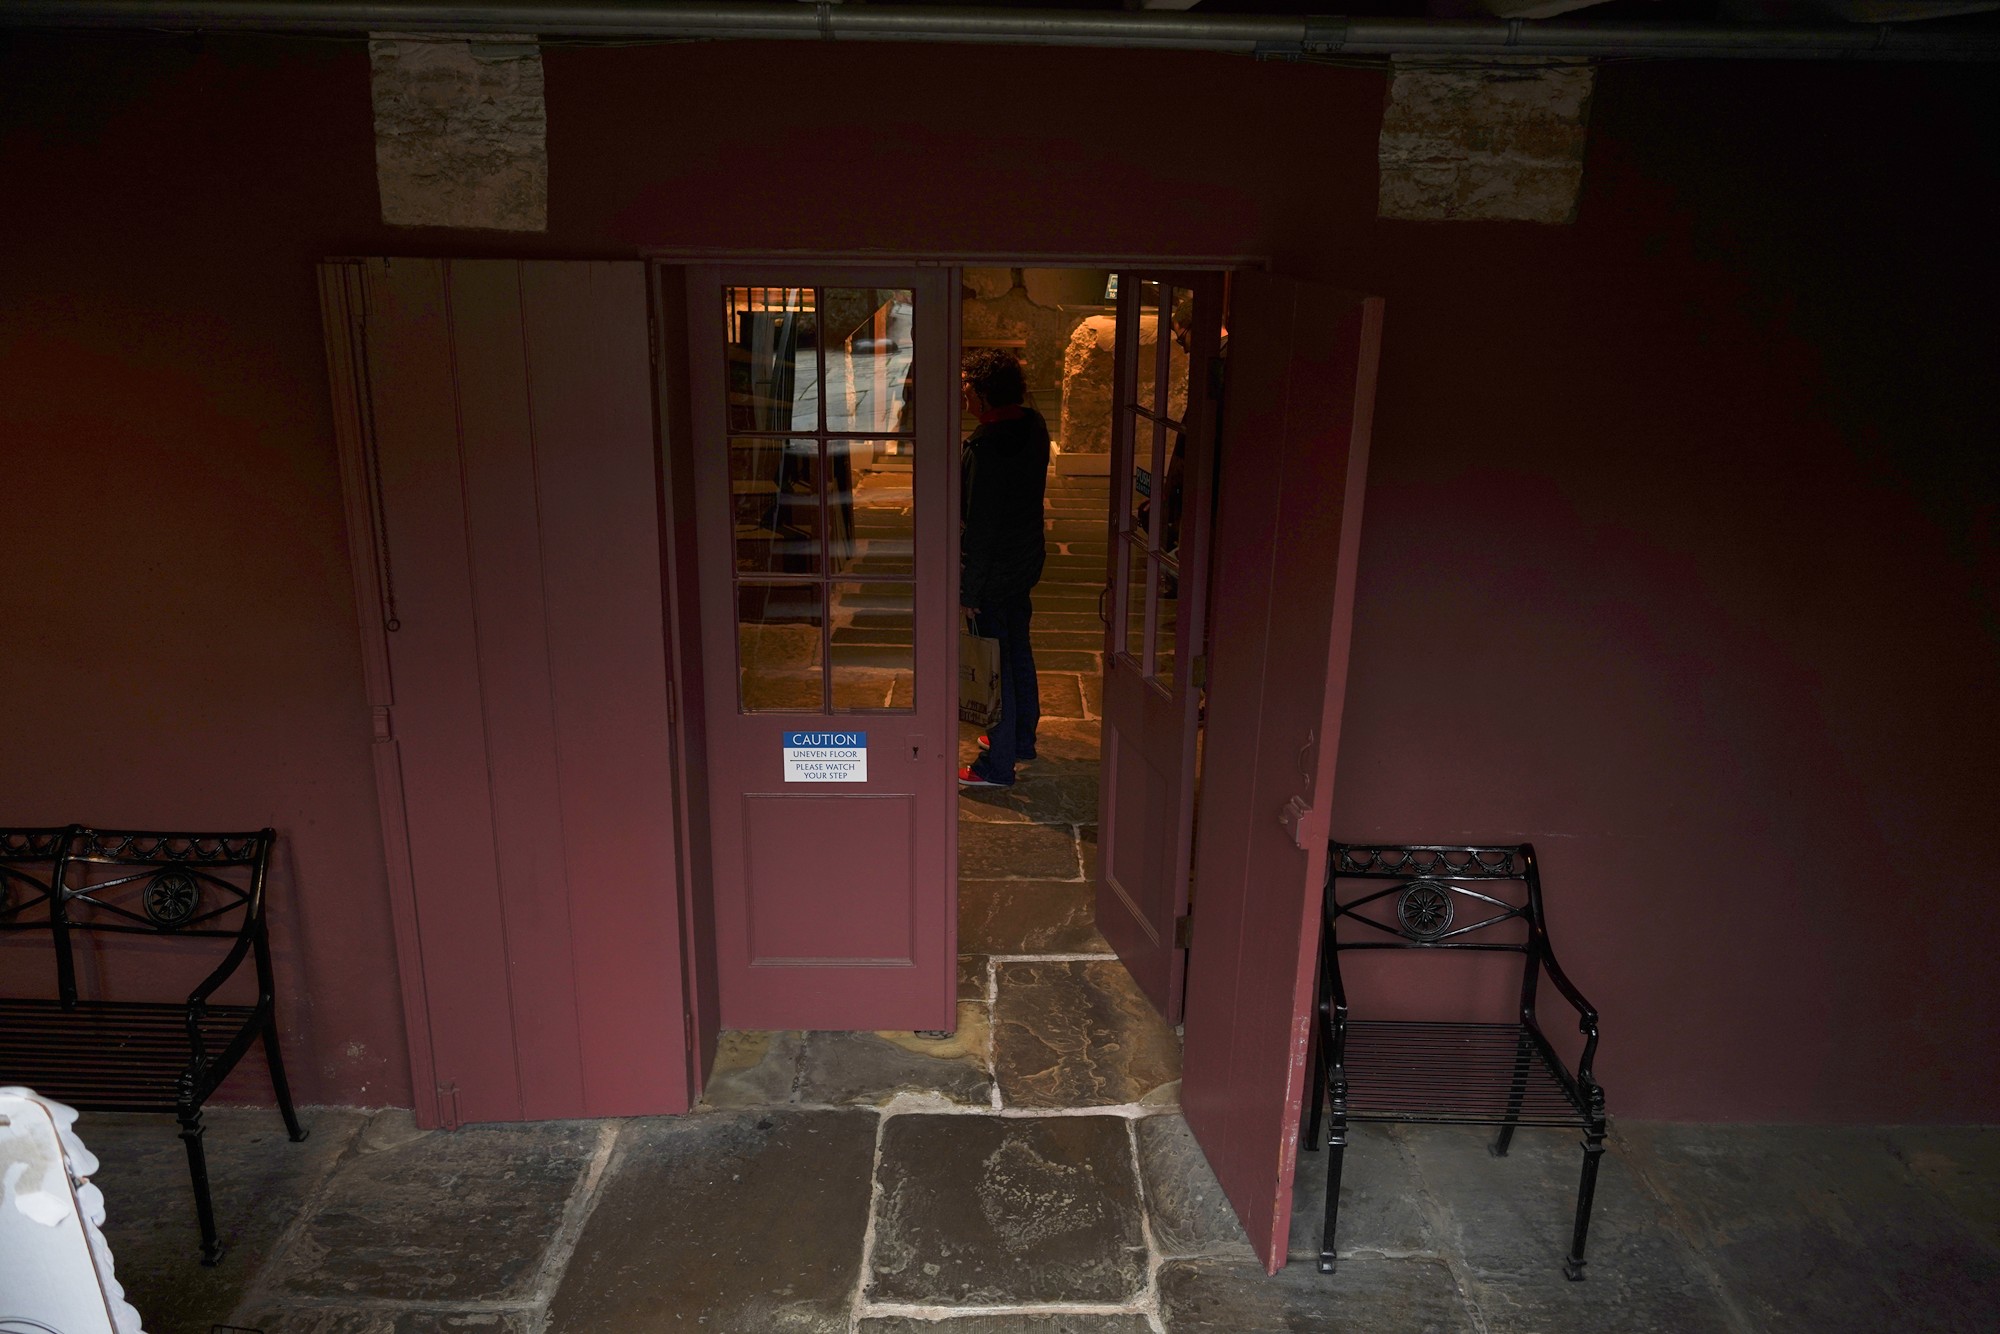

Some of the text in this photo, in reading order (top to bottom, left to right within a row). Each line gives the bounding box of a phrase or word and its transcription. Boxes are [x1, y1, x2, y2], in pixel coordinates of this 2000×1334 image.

[792, 734, 857, 746] CAUTION
[793, 750, 858, 758] UNEVEN FLOOR
[796, 763, 855, 771] PLEASE WATCH
[803, 772, 848, 780] YOUR STEP
